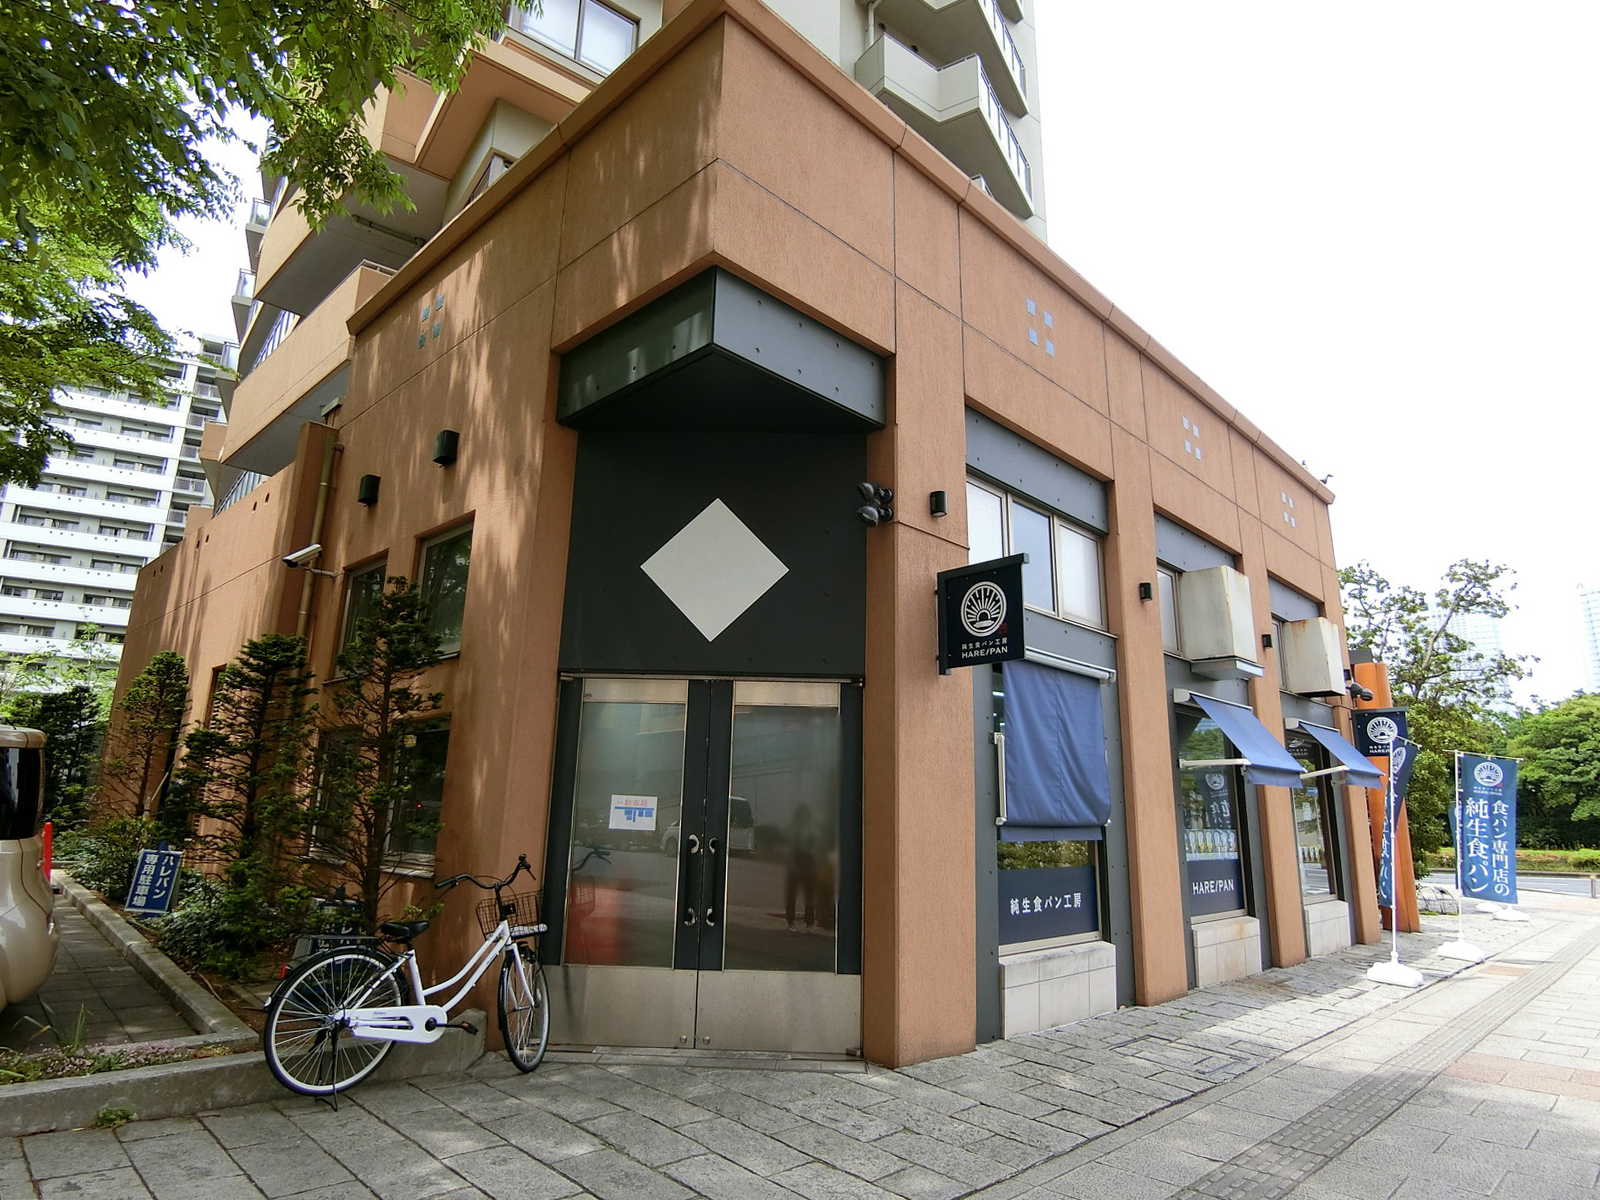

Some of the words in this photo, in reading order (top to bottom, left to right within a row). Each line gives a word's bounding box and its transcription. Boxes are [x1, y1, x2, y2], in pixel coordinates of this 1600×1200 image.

[961, 646, 1008, 659] HARE/PAN
[1465, 797, 1489, 893] 純生食パン
[1492, 799, 1510, 897] 食パン専門店の
[1192, 879, 1235, 895] HARE/PAN
[1010, 892, 1082, 915] 純生食パン工房
